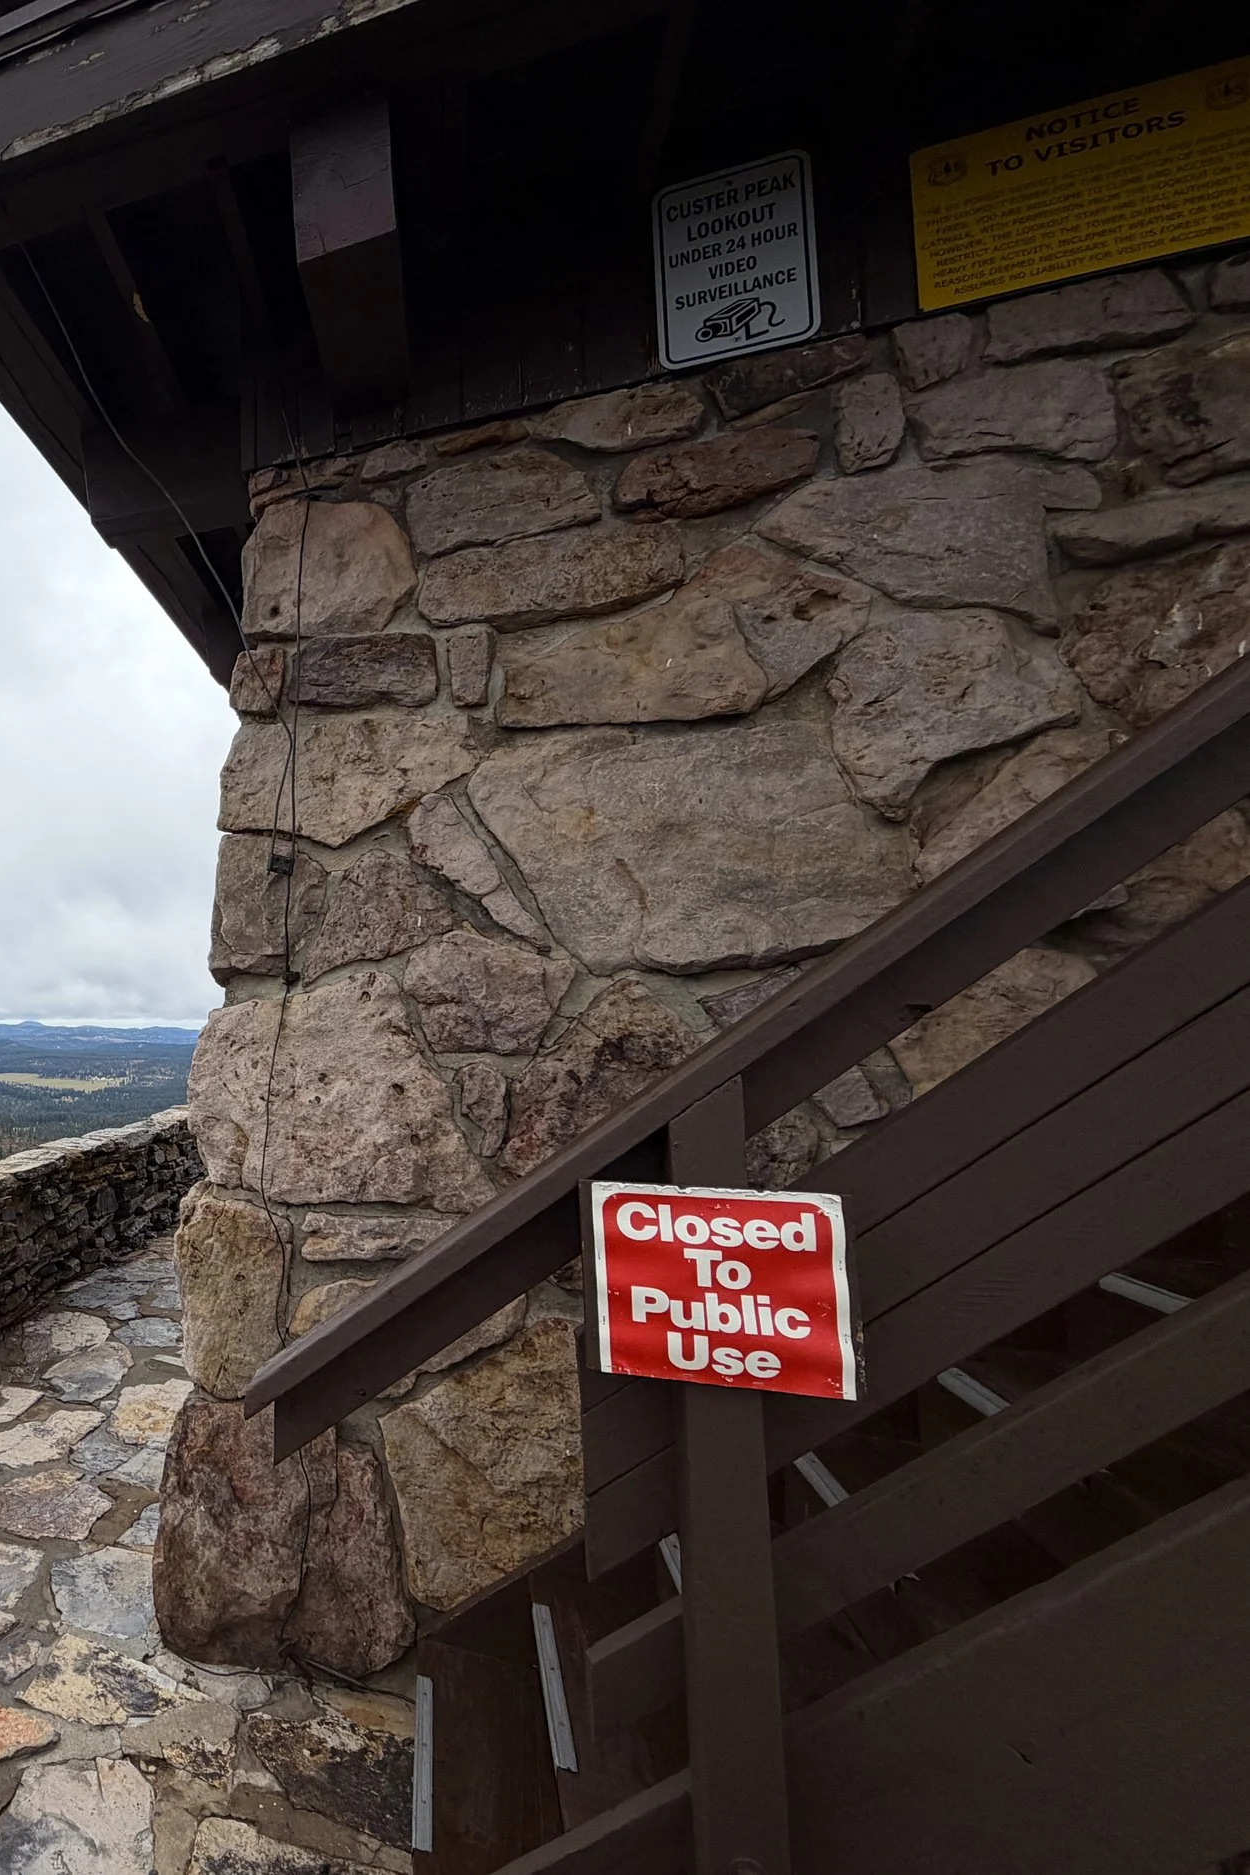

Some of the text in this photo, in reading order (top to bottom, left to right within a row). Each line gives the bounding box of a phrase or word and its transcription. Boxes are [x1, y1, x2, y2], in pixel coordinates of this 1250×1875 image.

[986, 154, 1024, 177] TO
[1034, 110, 1187, 162] VISITORS
[1025, 97, 1140, 142] NOTICE
[666, 171, 796, 223] CUSTER PEAK
[925, 214, 949, 226] THIS
[1053, 181, 1075, 193] FOR
[1080, 174, 1101, 186] THE
[1105, 155, 1175, 180] DETECTION
[1178, 150, 1192, 161] OF
[976, 212, 996, 224] YOU
[1001, 206, 1021, 218] ARE
[1026, 190, 1082, 211] WELCOME
[1087, 185, 1101, 196] TO
[1147, 167, 1170, 180] AND
[1177, 154, 1223, 173] ACCESS
[980, 220, 1009, 234] WITH
[1012, 201, 1083, 226] PERMISSION
[1087, 192, 1120, 207] FROM
[1125, 186, 1144, 198] THE
[1150, 170, 1207, 191] LOOKOUT
[1213, 163, 1231, 175] ON
[991, 231, 1011, 242] THE
[1015, 216, 1068, 236] LOOKOUT
[1074, 205, 1111, 221] STAFF
[1115, 199, 1137, 211] HAS
[1140, 191, 1167, 205] FULL
[1173, 172, 1242, 197] AUTHORITY
[668, 222, 798, 269] UNDER 24 HOUR
[687, 202, 776, 242] LOOKOUT
[932, 263, 967, 278] HEAVY
[970, 256, 996, 269] FIRE
[1128, 210, 1184, 230] WEATHER
[1189, 204, 1207, 216] OR
[1211, 197, 1234, 210] FOR
[936, 247, 989, 266] RESTRICT
[992, 235, 1036, 252] ACCESS
[1041, 230, 1055, 240] TO
[1059, 224, 1080, 236] THE
[1084, 212, 1126, 230] TOWER
[1130, 199, 1178, 219] DURING
[1183, 185, 1236, 206] PERIODS
[708, 255, 757, 280] VIDEO
[934, 269, 985, 288] REASONS
[989, 257, 1034, 275] DEEMED
[1113, 233, 1134, 245] THE
[1159, 215, 1208, 234] FOREST
[953, 275, 1005, 294] ASSUMES
[1009, 270, 1026, 281] NO
[1029, 256, 1085, 276] LIABILITY
[1089, 249, 1113, 262] FOR
[1116, 237, 1165, 256] VISITOR
[675, 267, 797, 311] SURVEILLANCE
[616, 1201, 817, 1252] Closed
[683, 1248, 752, 1290] To
[631, 1286, 811, 1339] Public
[667, 1332, 782, 1379] Use
